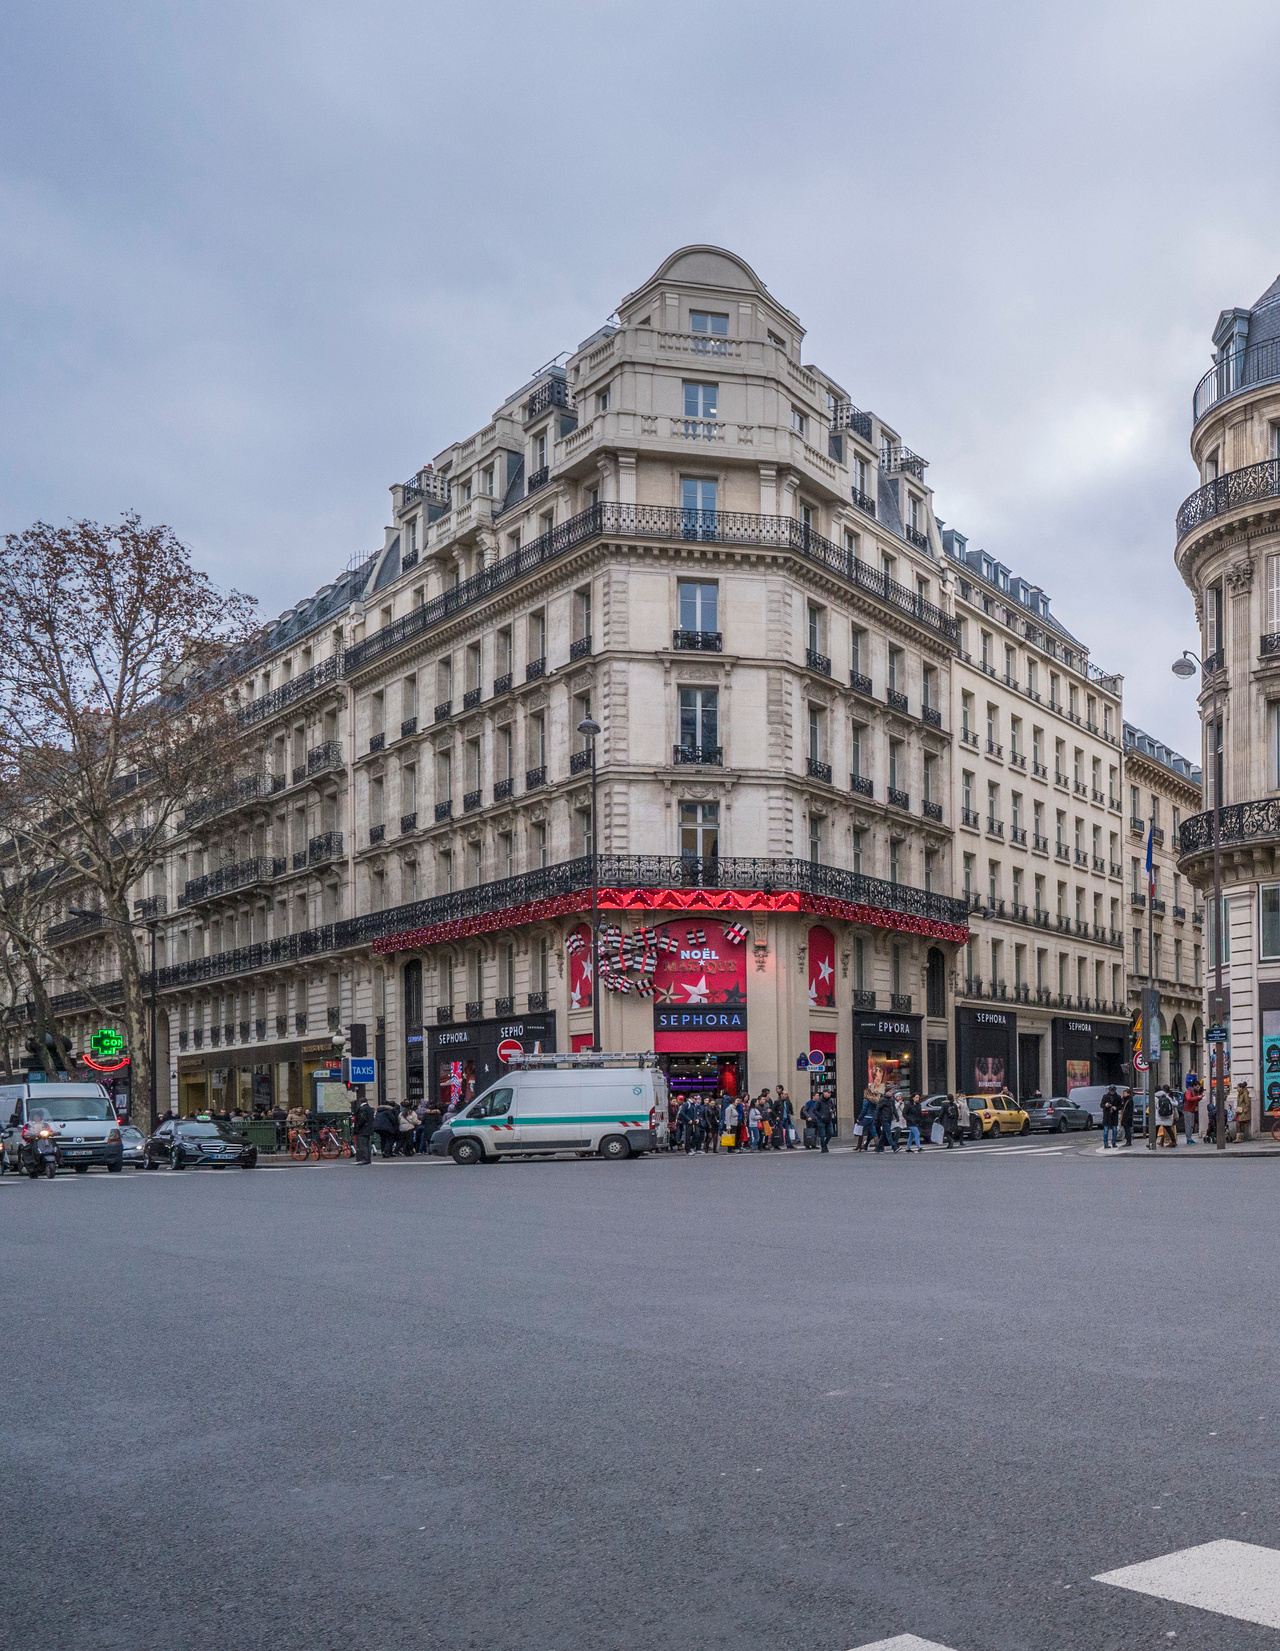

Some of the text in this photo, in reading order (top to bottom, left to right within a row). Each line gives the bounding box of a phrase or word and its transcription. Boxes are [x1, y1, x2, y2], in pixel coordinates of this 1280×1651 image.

[680, 948, 719, 959] NOËL
[664, 961, 737, 974] MAGIQUE
[660, 1014, 741, 1026] SEPHORA
[976, 1012, 1006, 1024] SEPHORA
[1068, 1022, 1092, 1032] SEPHORA
[438, 1032, 468, 1044] SEPHORA
[352, 1066, 374, 1075] TAXIS
